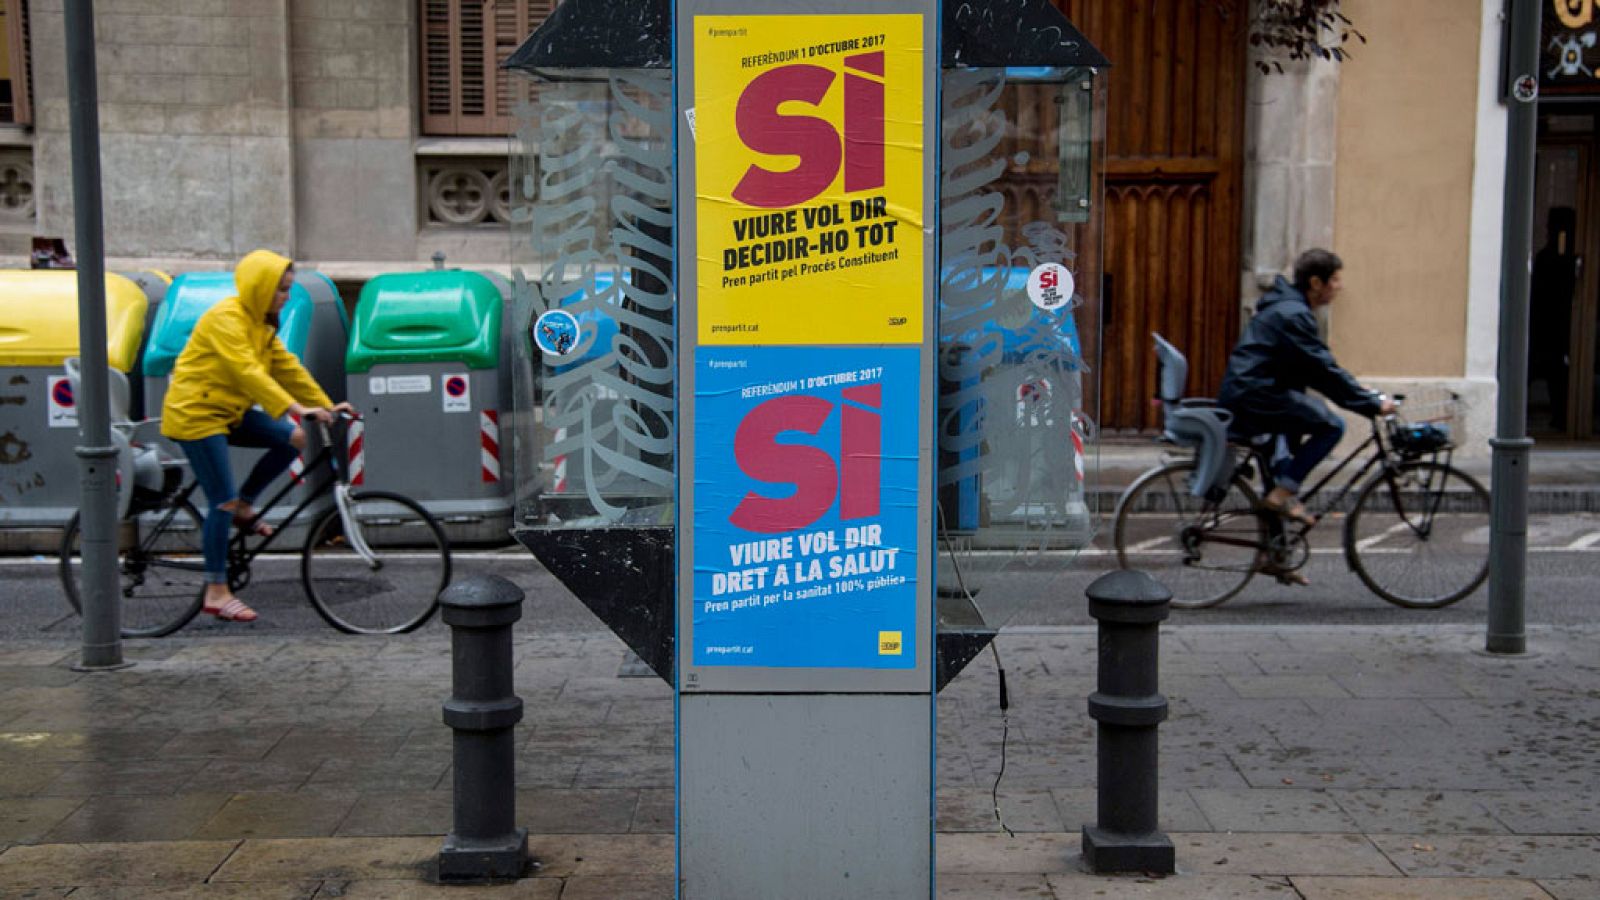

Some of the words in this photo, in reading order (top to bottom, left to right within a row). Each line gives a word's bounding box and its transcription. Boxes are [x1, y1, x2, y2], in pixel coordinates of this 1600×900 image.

[801, 47, 806, 58] 1
[808, 38, 860, 57] D'OCTUBRE
[862, 33, 886, 48] 2017
[732, 210, 798, 242] VIURE
[803, 203, 845, 230] VOL
[850, 196, 888, 222] DIR
[723, 229, 850, 272] DECIDIR-HO
[854, 220, 899, 249] TOT
[722, 275, 746, 288] Pren
[749, 269, 779, 287] partit
[780, 265, 798, 281] pel
[800, 258, 837, 276] Procés
[838, 248, 899, 269] Constituent
[800, 379, 805, 390] 1
[807, 370, 857, 388] D'OCTUBRE
[859, 366, 883, 381] 2017
[729, 536, 793, 567] VIURE
[798, 530, 840, 556] VOL
[845, 524, 882, 549] DIR
[711, 567, 769, 596] DRET
[773, 564, 790, 587] A
[794, 558, 823, 584] LA
[829, 547, 899, 579] SALUT
[704, 600, 729, 613] Pren
[731, 595, 760, 612] partit
[763, 592, 780, 607] per
[783, 590, 793, 601] la
[796, 582, 832, 600] sanitat
[835, 578, 865, 594] 100%
[867, 574, 906, 592] pública
